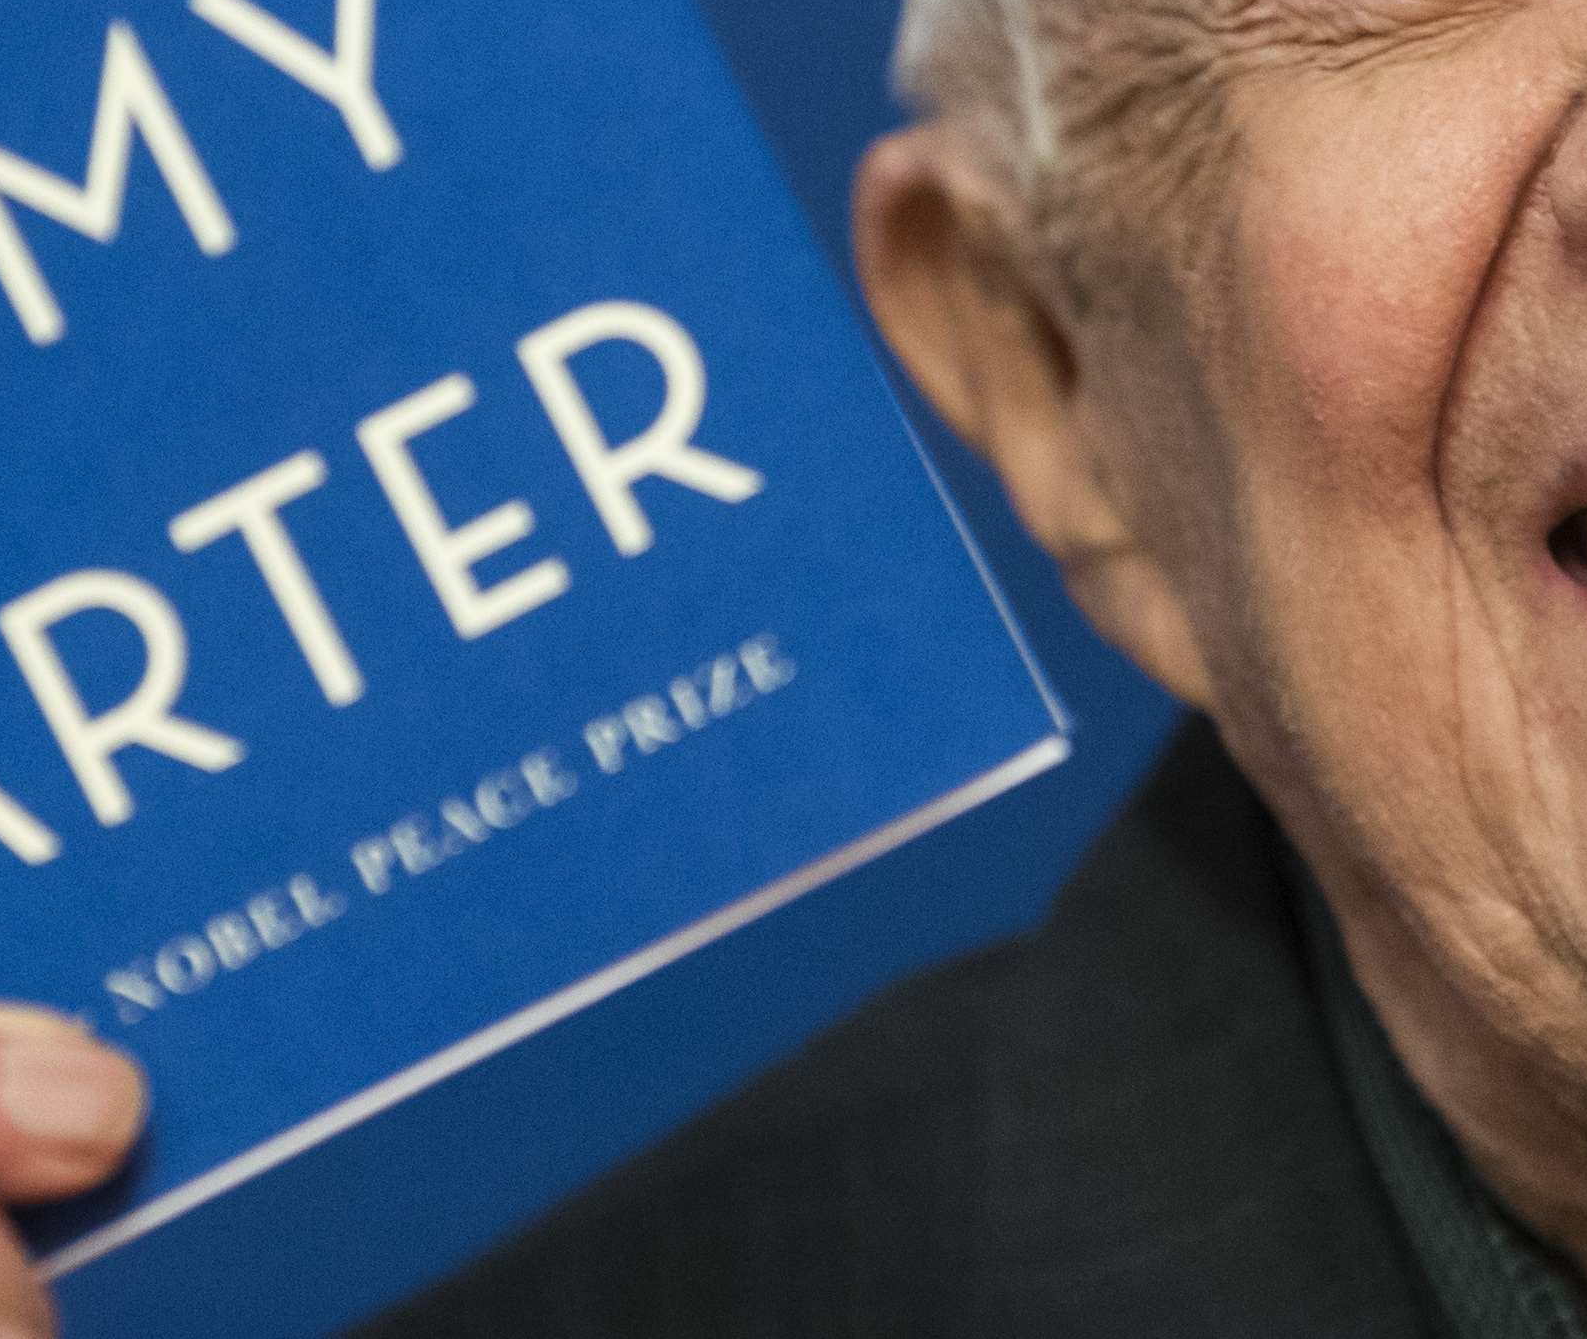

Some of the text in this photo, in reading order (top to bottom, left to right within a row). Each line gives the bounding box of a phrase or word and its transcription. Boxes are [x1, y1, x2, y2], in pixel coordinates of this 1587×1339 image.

[102, 630, 798, 1026] NOBEL PEACE PRIZE
